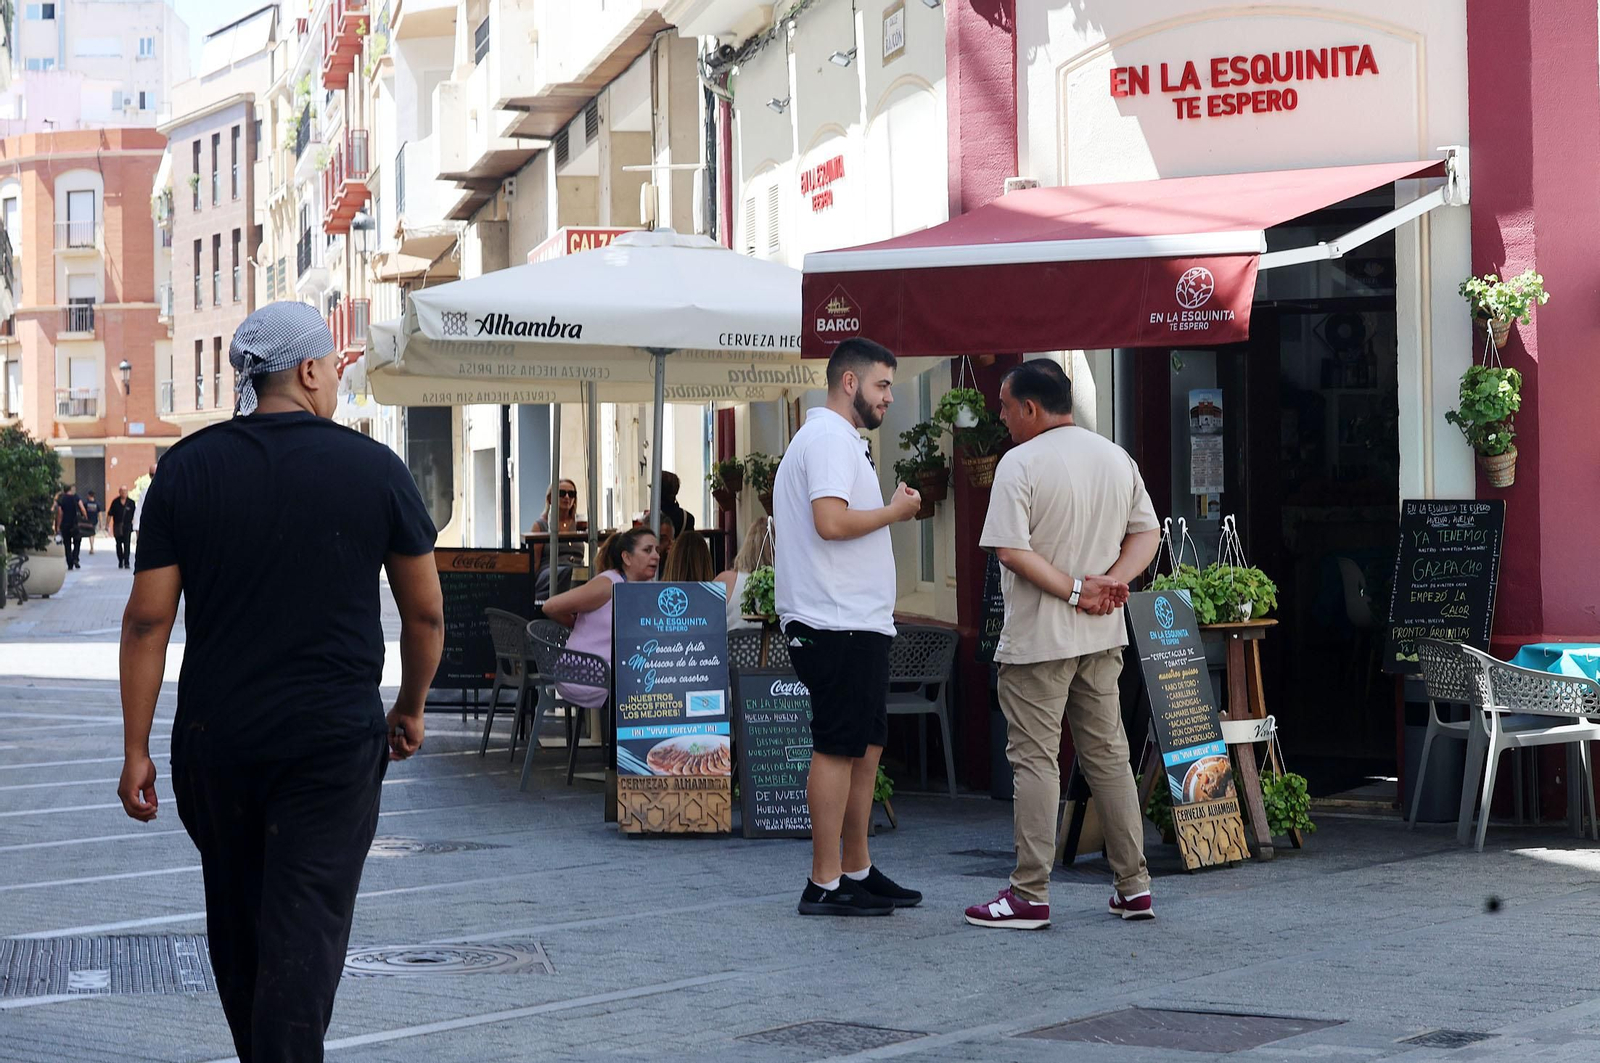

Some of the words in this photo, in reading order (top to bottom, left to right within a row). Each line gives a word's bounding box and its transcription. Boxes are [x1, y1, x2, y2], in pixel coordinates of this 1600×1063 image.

[1110, 65, 1149, 97] EN
[1160, 60, 1201, 92] LA
[1210, 44, 1379, 88] ESQUINITA
[1172, 97, 1201, 120] TE
[1207, 88, 1298, 117] ESPERO
[1150, 313, 1164, 323] EN
[1167, 312, 1178, 323] LA
[1181, 310, 1235, 322] ESQUINITA
[474, 312, 582, 339] Alhambra
[816, 318, 859, 332] BARCO
[1170, 323, 1177, 331] TE
[1179, 322, 1209, 331] ESPERO
[719, 333, 775, 348] CERVEZA
[1407, 503, 1417, 512] EN
[1419, 503, 1426, 513] LA
[1460, 504, 1467, 512] TE
[1469, 503, 1491, 513] ESPERO
[1413, 530, 1430, 547] YA
[1437, 529, 1488, 544] TENEMOS
[452, 554, 498, 570] Coca-Cola
[1412, 558, 1482, 581] GAZPACHO
[1454, 589, 1466, 602] LA
[1440, 603, 1470, 616] CALOR
[641, 618, 651, 626] EN
[654, 618, 664, 626] LA
[666, 617, 708, 626] ESQUINITA
[1149, 631, 1157, 639] EN
[1157, 630, 1165, 639] LA
[1392, 627, 1426, 639] PRONTO
[685, 641, 706, 656] frito
[628, 654, 675, 672] Mariscos
[676, 657, 686, 667] de
[688, 656, 697, 666] la
[699, 655, 720, 667] costa
[644, 668, 677, 692] Guisos
[679, 673, 709, 683] caseros
[620, 701, 654, 711] CHOCOS
[655, 701, 683, 710] FRITOS
[623, 711, 639, 719] LOS
[640, 709, 680, 719] MEJORES!
[1170, 718, 1191, 728] BACALAO
[621, 778, 669, 790] CERVEZAS
[673, 778, 729, 790] ALHAMBRA
[756, 790, 770, 802] DE
[1176, 805, 1206, 822] CERVEZAS
[1207, 801, 1239, 817] ALHAMBRA
